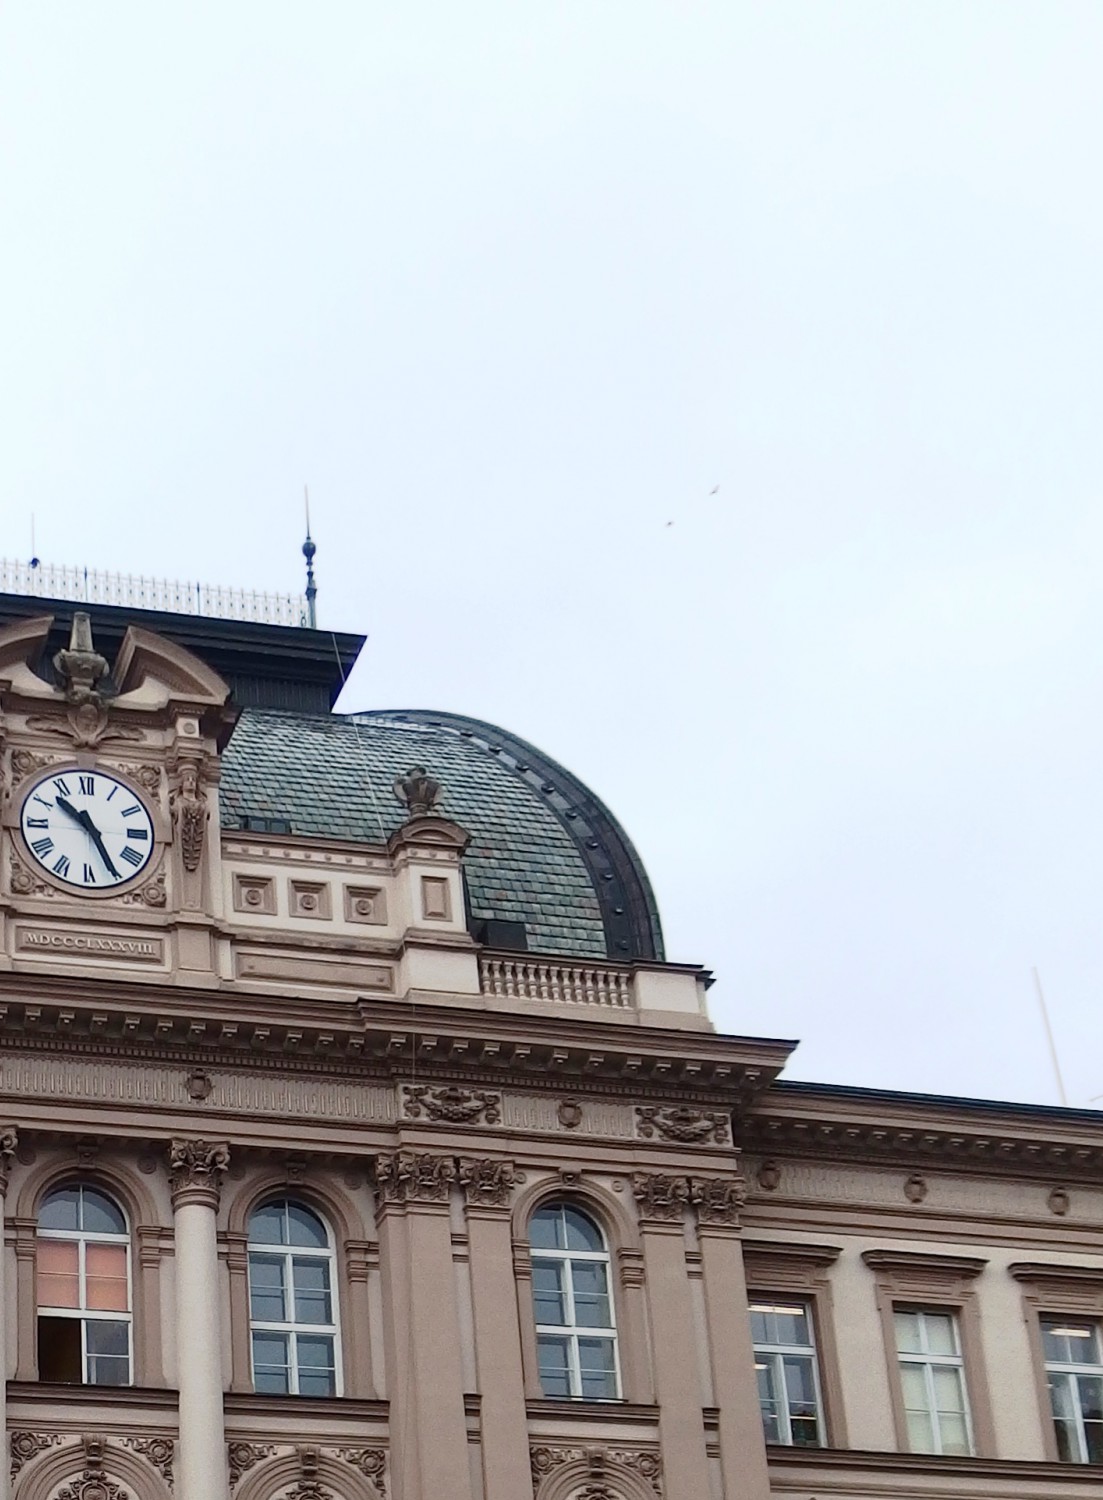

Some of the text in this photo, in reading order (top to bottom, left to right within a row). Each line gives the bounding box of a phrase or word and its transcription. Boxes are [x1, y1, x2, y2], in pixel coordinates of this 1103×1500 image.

[79, 776, 95, 796] XII
[106, 785, 118, 801] I
[33, 794, 54, 811] X
[121, 805, 142, 817] II
[126, 828, 148, 840] III
